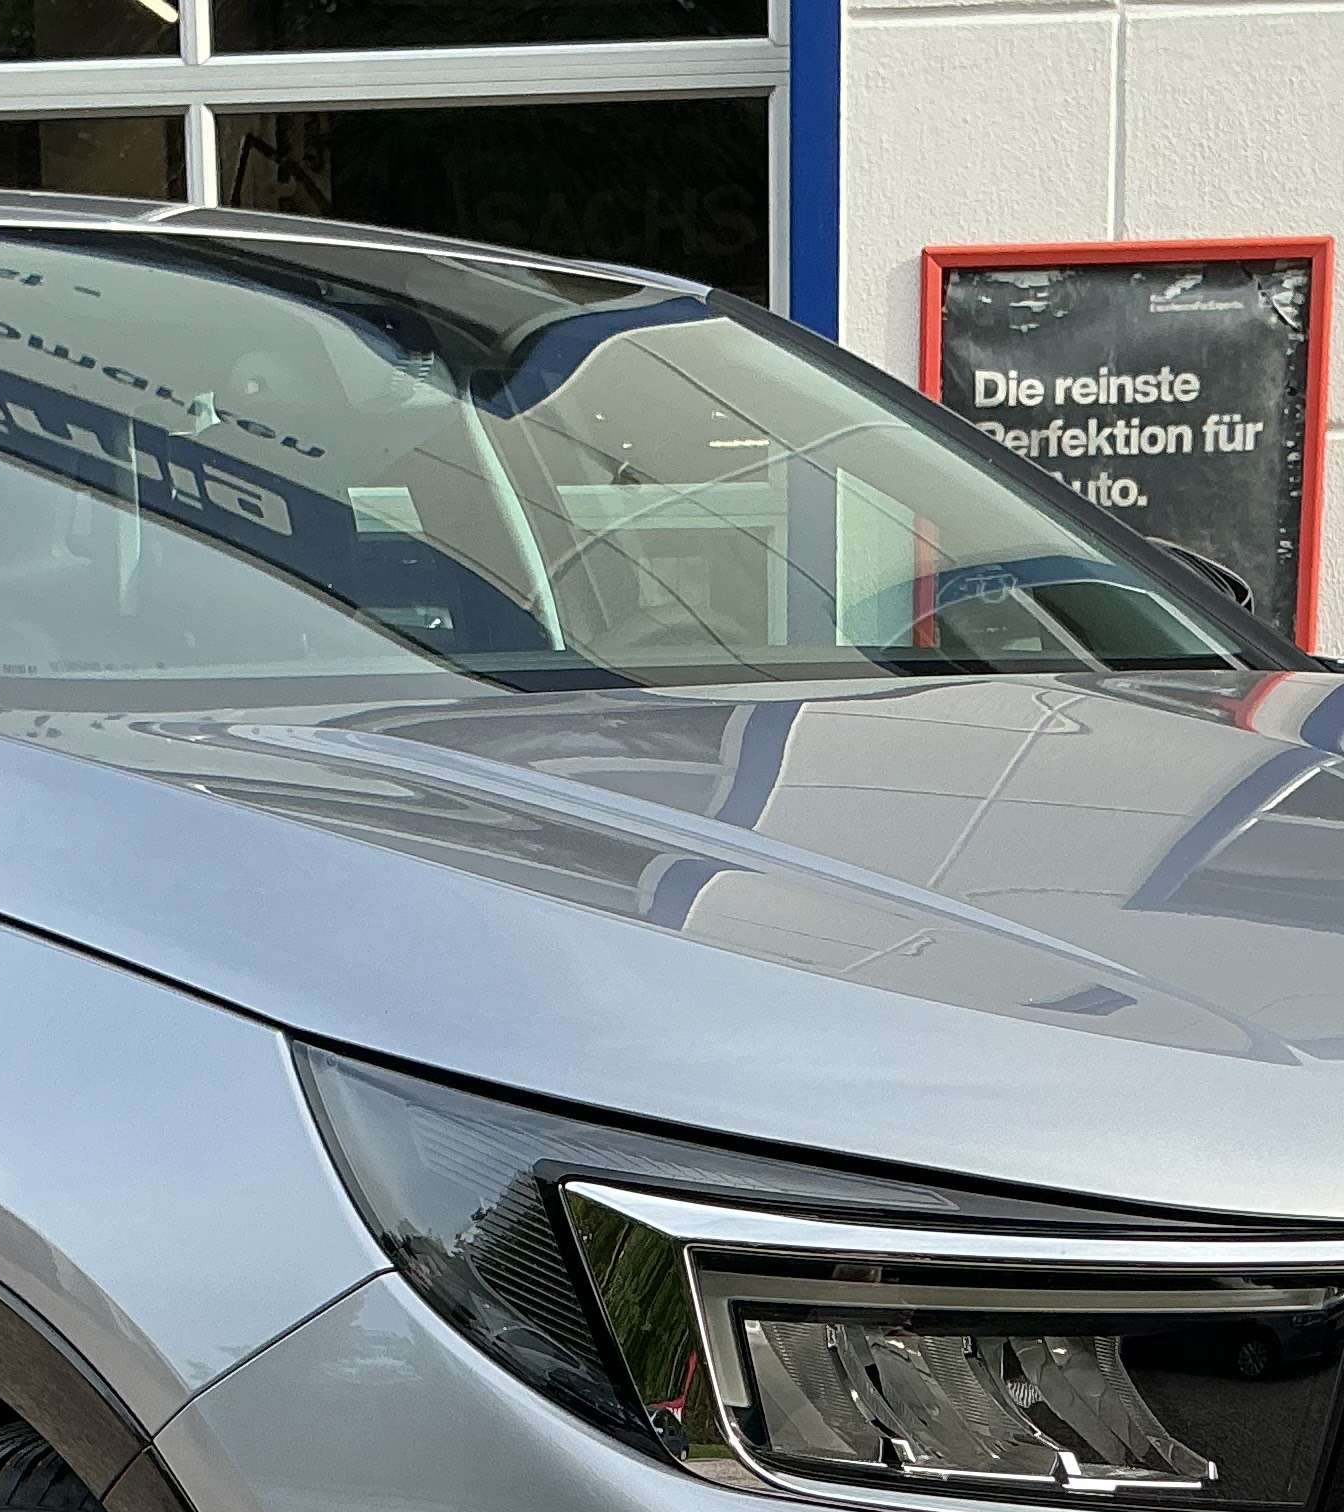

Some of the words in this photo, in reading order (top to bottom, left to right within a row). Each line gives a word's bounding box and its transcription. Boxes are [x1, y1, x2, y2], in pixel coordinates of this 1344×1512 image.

[974, 368, 1044, 407] Die
[1054, 366, 1201, 404] reinste
[975, 416, 1192, 458] Perfektion
[1202, 414, 1264, 454] für
[1048, 471, 1148, 507] uto.
